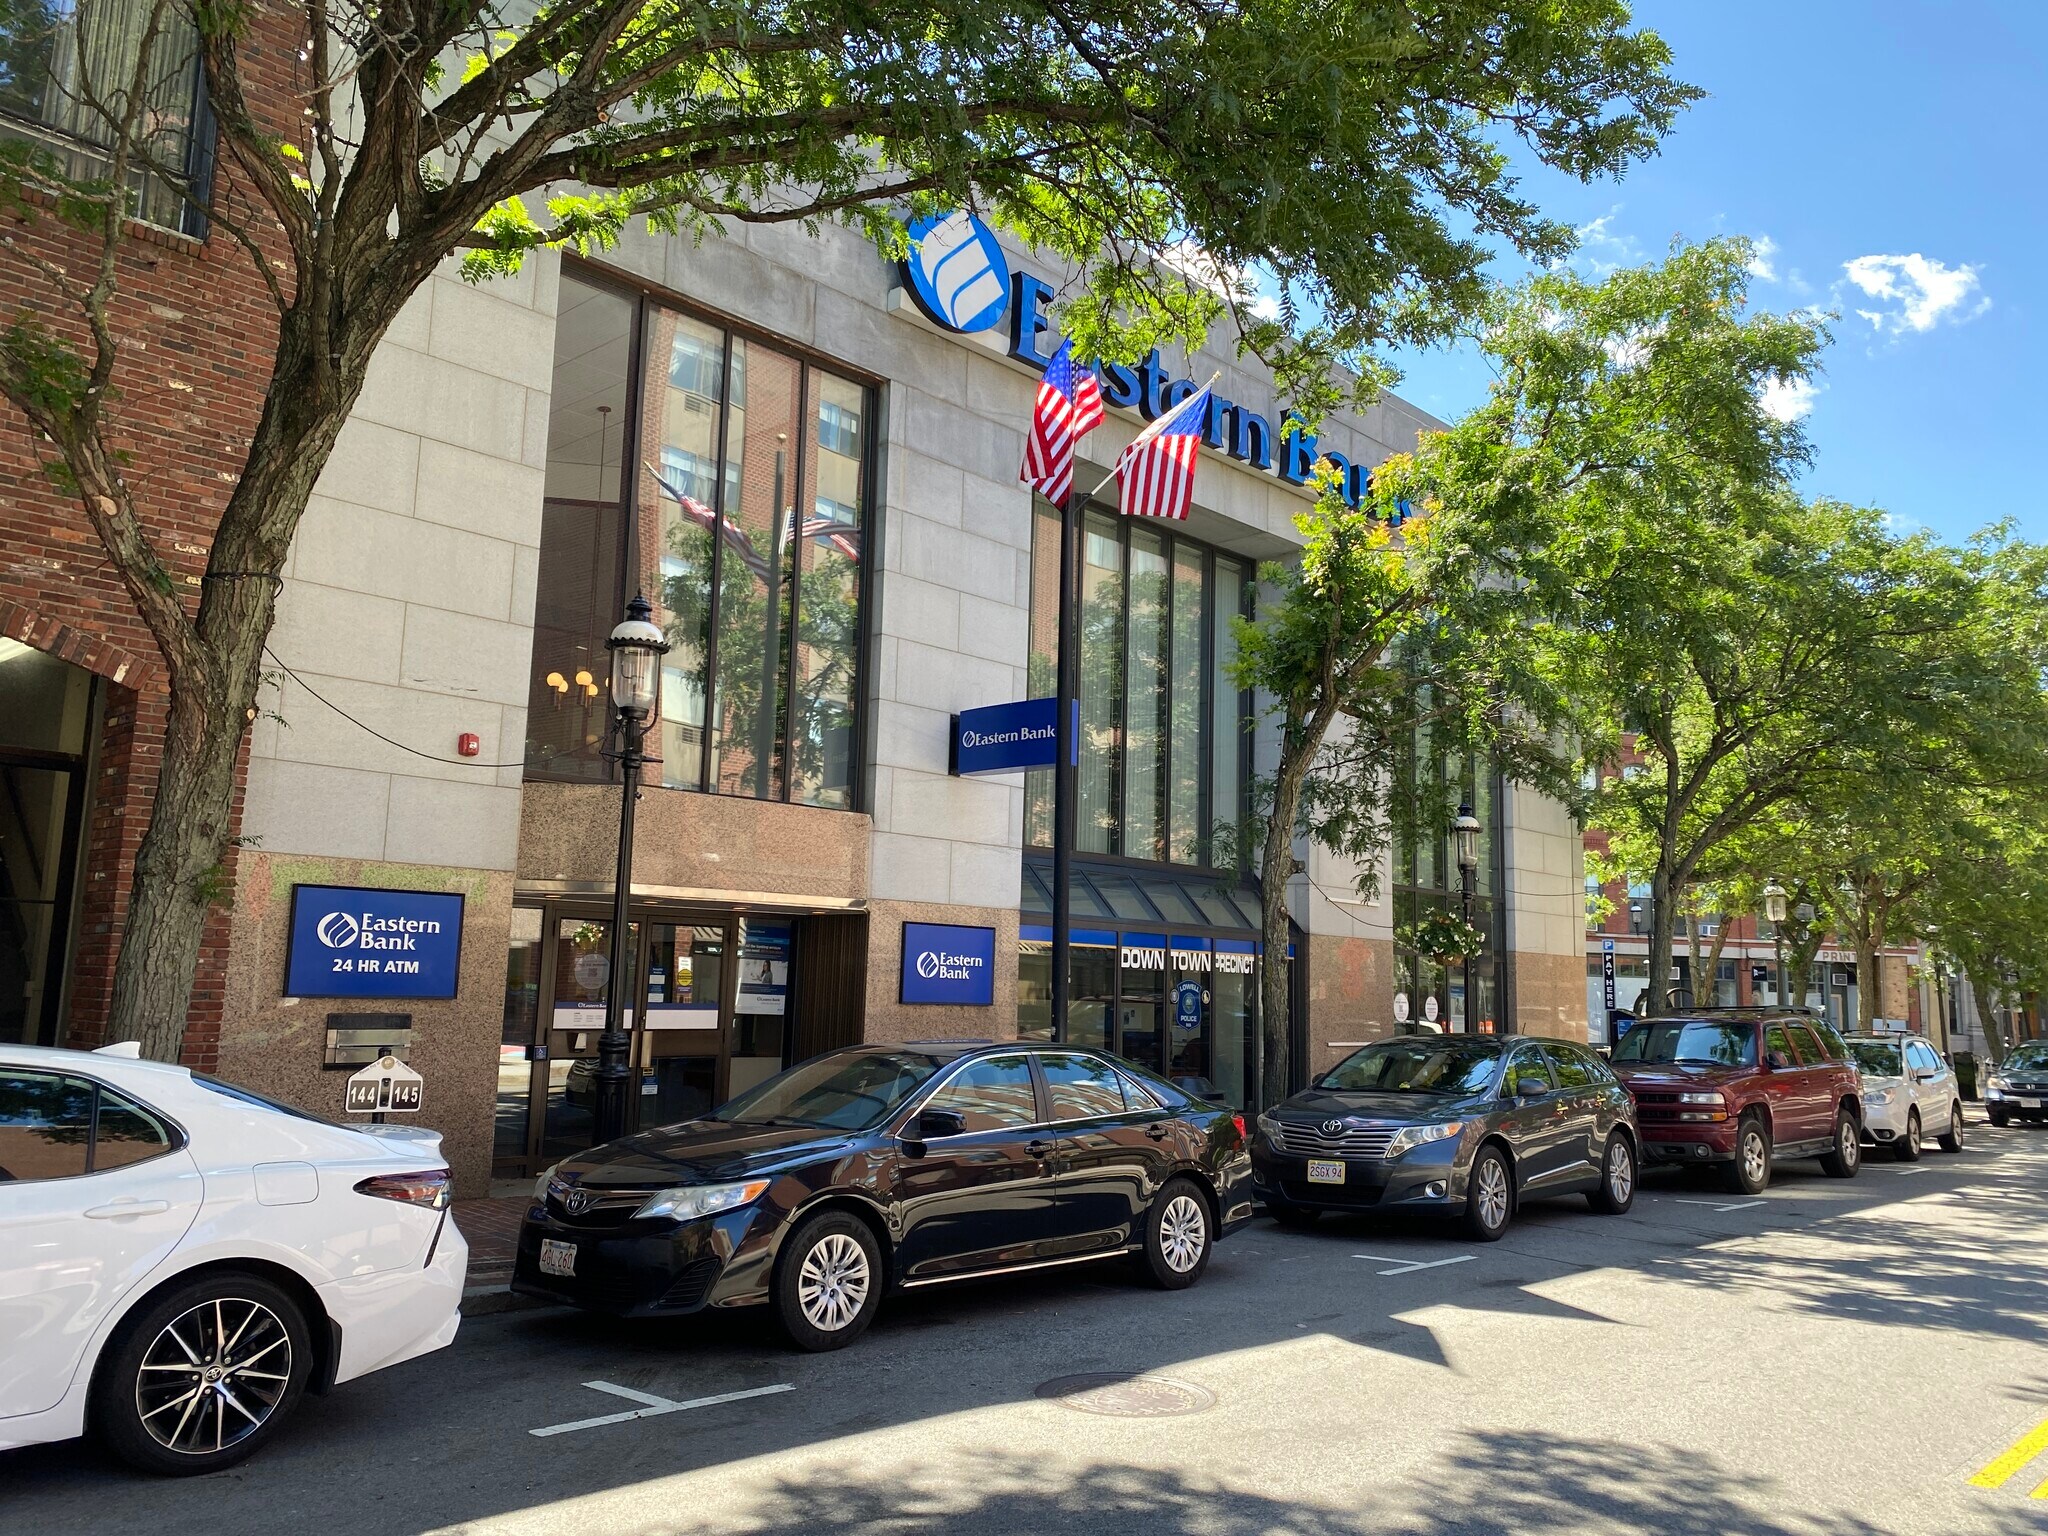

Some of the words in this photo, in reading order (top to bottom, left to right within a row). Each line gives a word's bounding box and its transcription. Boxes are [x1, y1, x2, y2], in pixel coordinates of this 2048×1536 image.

[975, 730, 1018, 746] Eastern
[1020, 725, 1056, 740] Bank
[361, 913, 440, 934] Eastern
[360, 932, 416, 951] Bank
[1604, 941, 1612, 950] P
[332, 958, 353, 972] 24
[357, 959, 380, 973] HR
[384, 960, 419, 974] ATM
[940, 952, 983, 967] Eastern
[1121, 948, 1165, 970] DOWN
[1170, 951, 1212, 972] TOWN
[1605, 954, 1613, 976] PAY
[940, 966, 970, 980] Bank
[1179, 983, 1200, 993] LOWELL
[1606, 979, 1614, 1008] HERE
[350, 1086, 375, 1103] 144
[394, 1086, 419, 1103] 145
[1310, 1166, 1330, 1177] 2SGX
[1331, 1167, 1342, 1178] 94
[557, 1251, 573, 1269] 260
